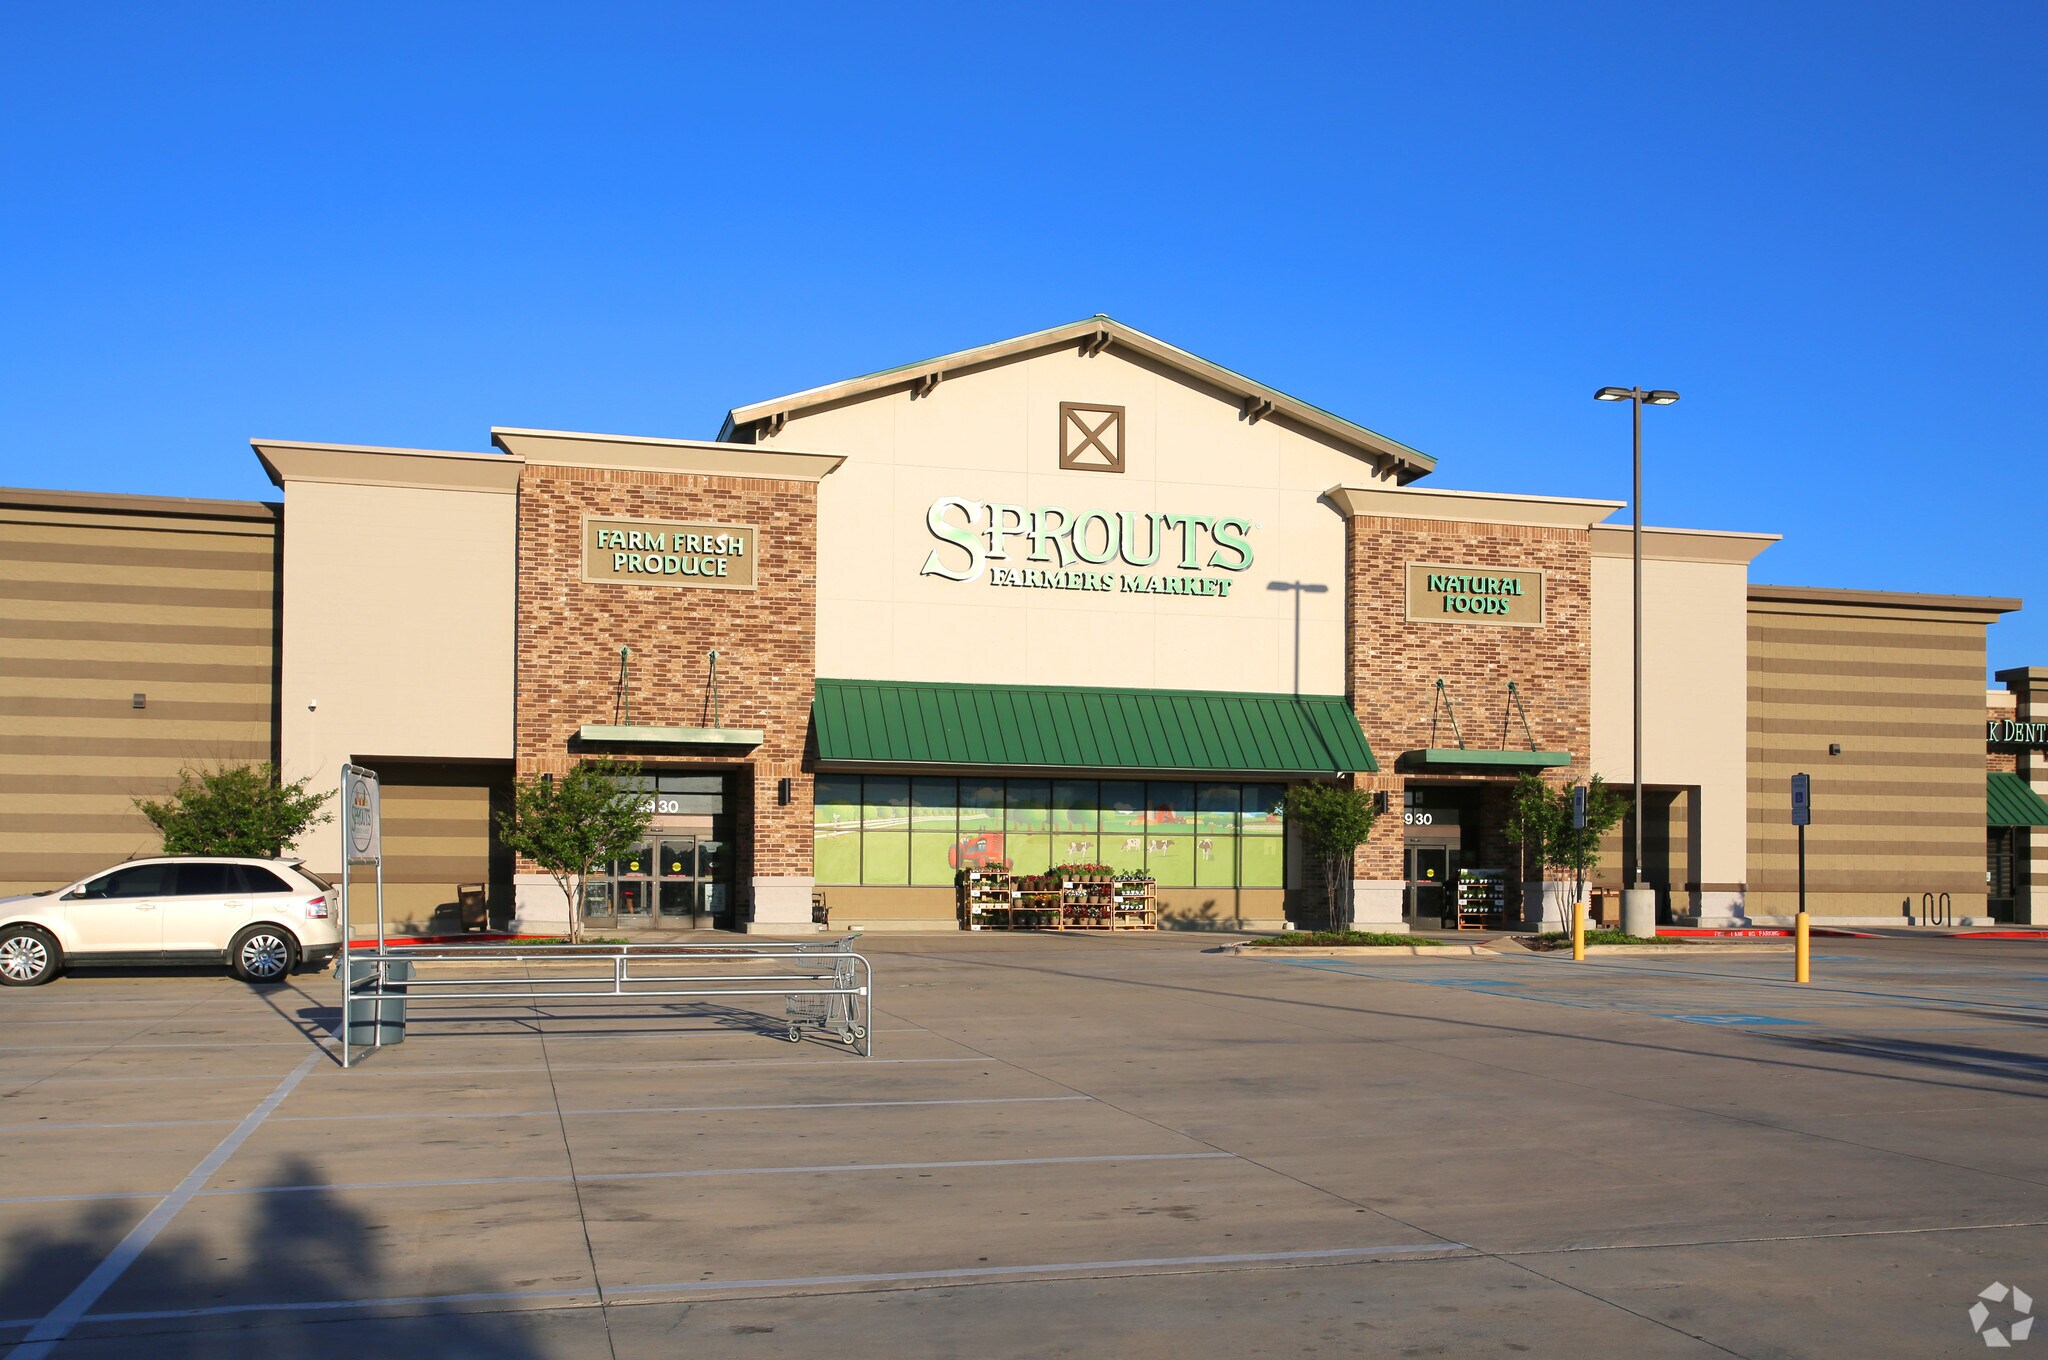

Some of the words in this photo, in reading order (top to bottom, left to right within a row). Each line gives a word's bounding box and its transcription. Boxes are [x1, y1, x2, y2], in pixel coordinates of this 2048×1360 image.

[597, 529, 666, 552] FARM
[672, 533, 745, 556] FRESH
[919, 495, 1255, 583] SPROUTS
[613, 552, 728, 577] PRODUCE
[989, 567, 1117, 593] FARMERS
[1119, 574, 1234, 598] MARKET
[1427, 573, 1526, 596] NATURAL
[1443, 594, 1511, 615] FOODS
[1986, 721, 2000, 742] K
[1403, 812, 1433, 825] 930
